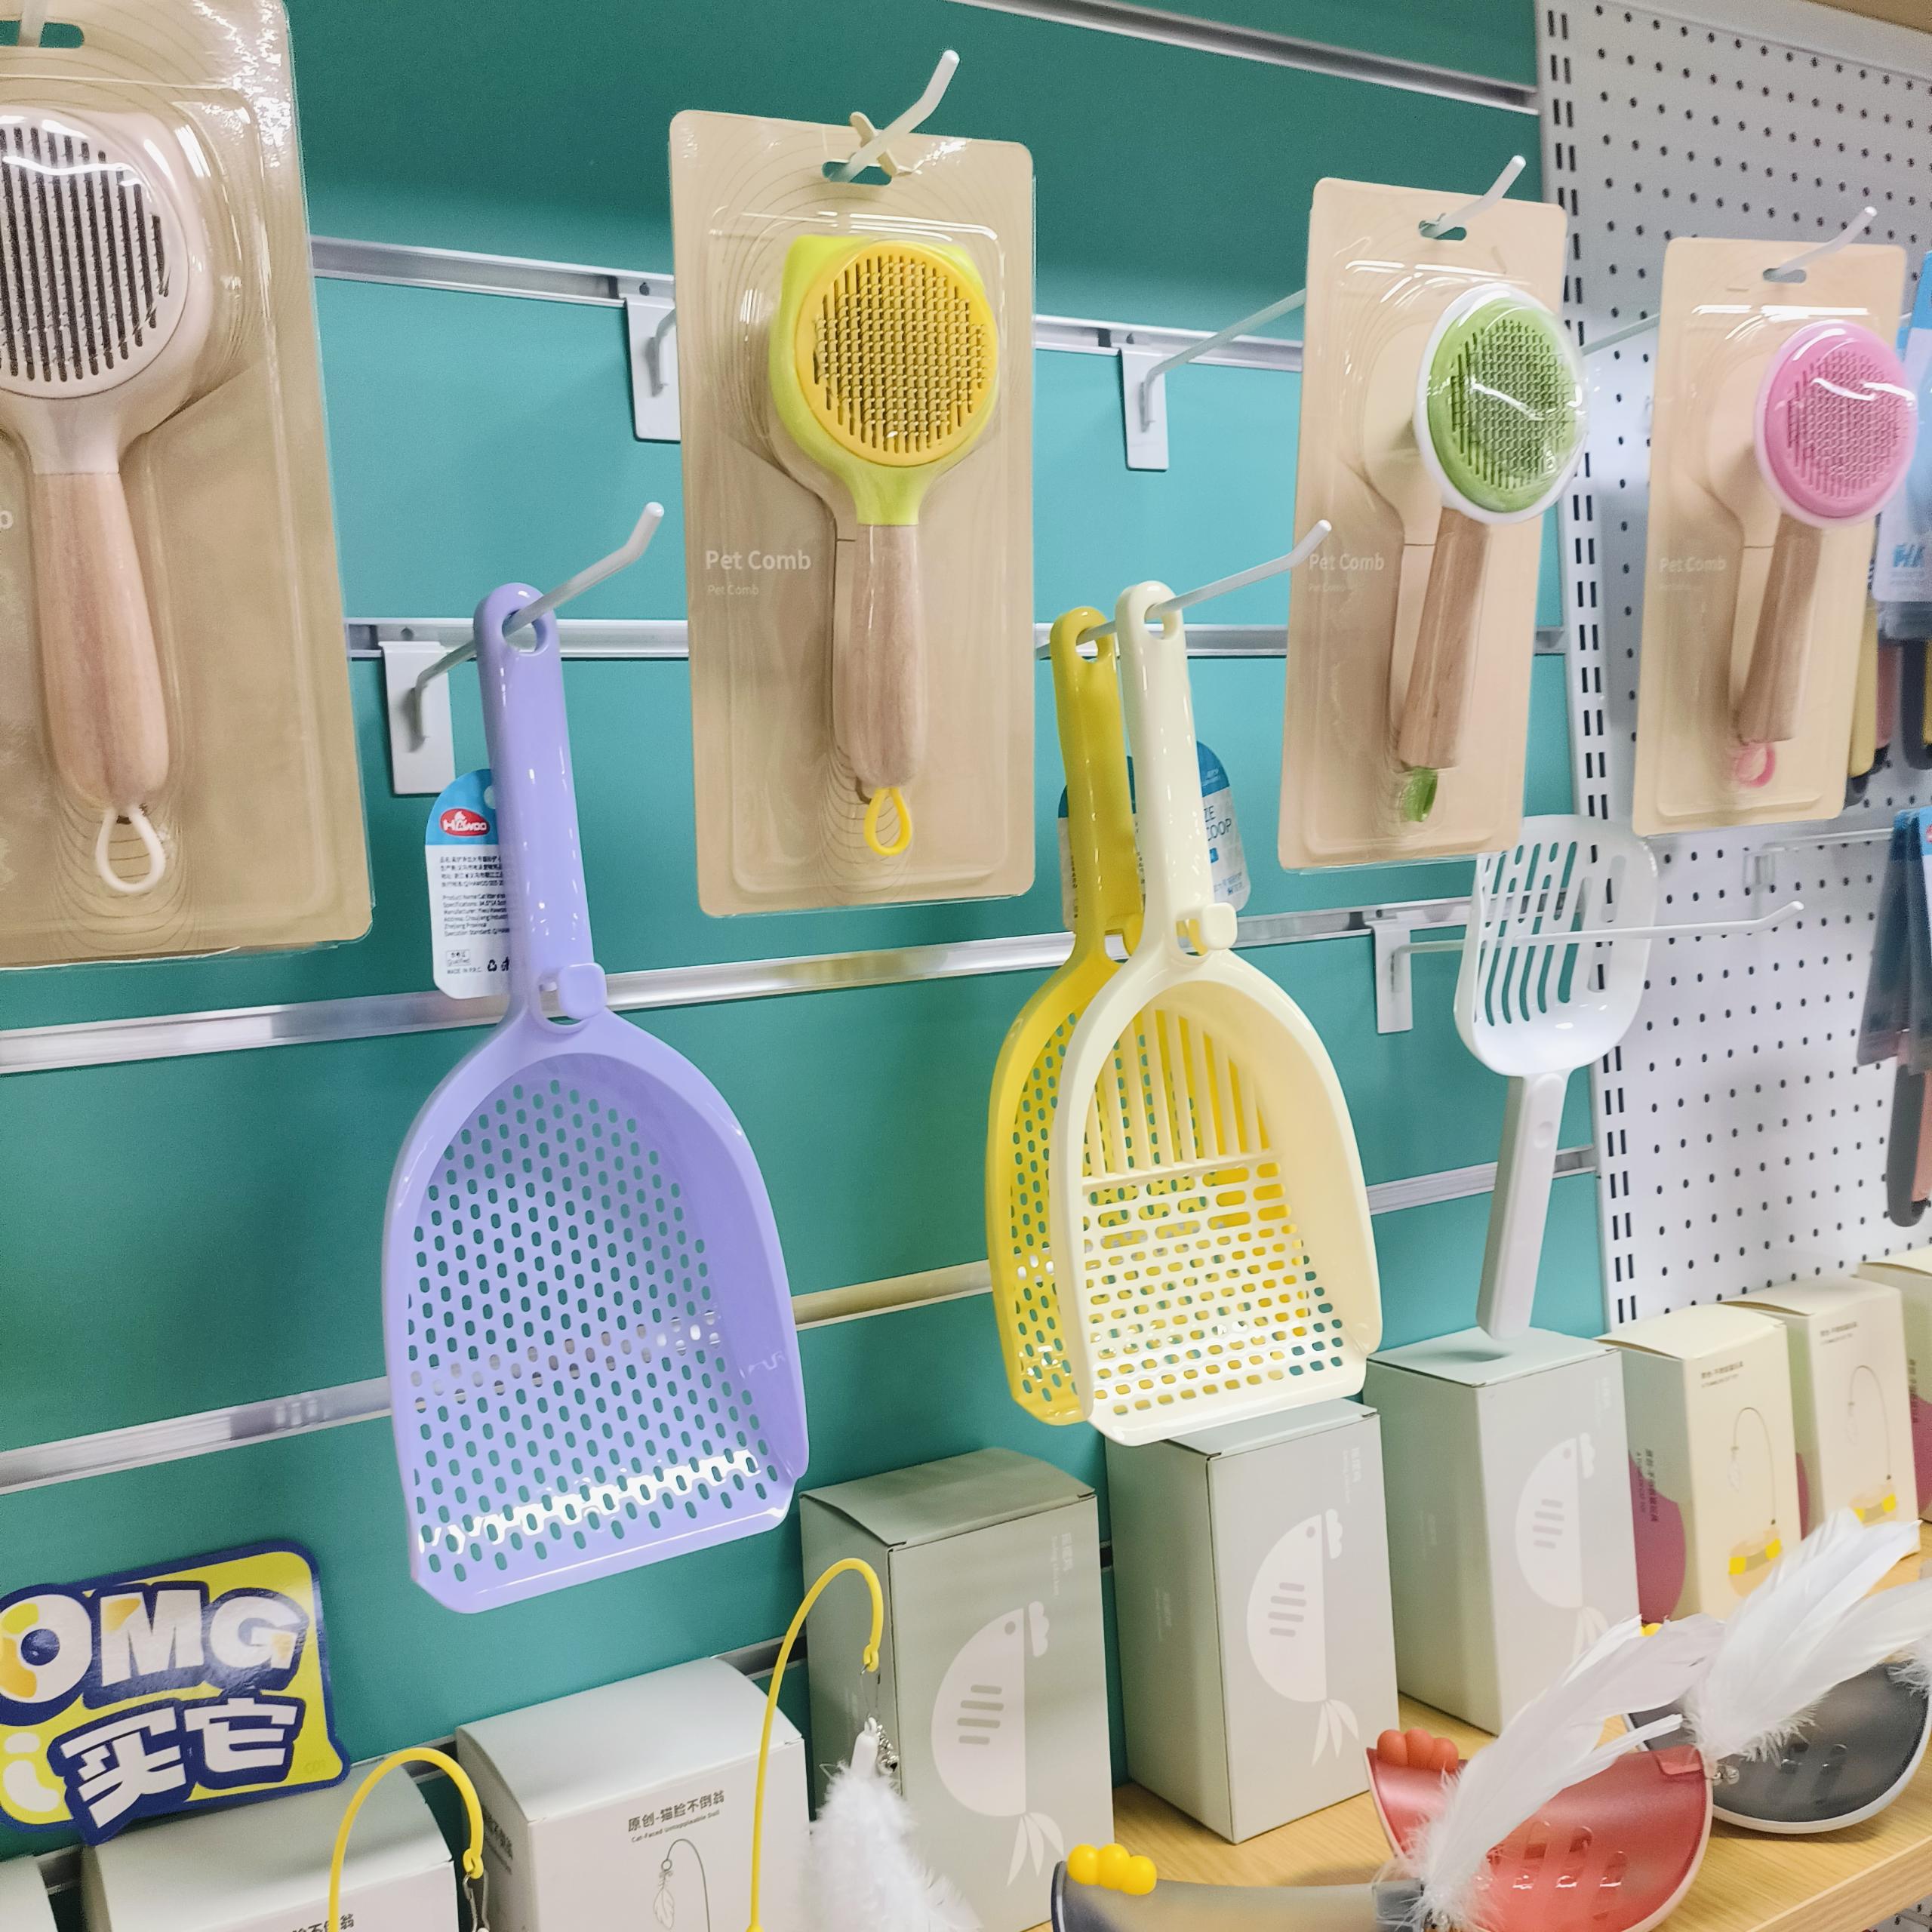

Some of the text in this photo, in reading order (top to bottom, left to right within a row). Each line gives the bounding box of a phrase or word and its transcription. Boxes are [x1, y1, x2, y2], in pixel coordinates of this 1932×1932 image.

[705, 549, 811, 570] Pet Comb
[1309, 551, 1384, 571] Pet Comb
[707, 583, 759, 595] Pet Comb
[0, 1590, 298, 1704] OMG
[60, 1698, 298, 1828] 买它
[628, 1789, 724, 1832] 原创-猫脸不倒翁
